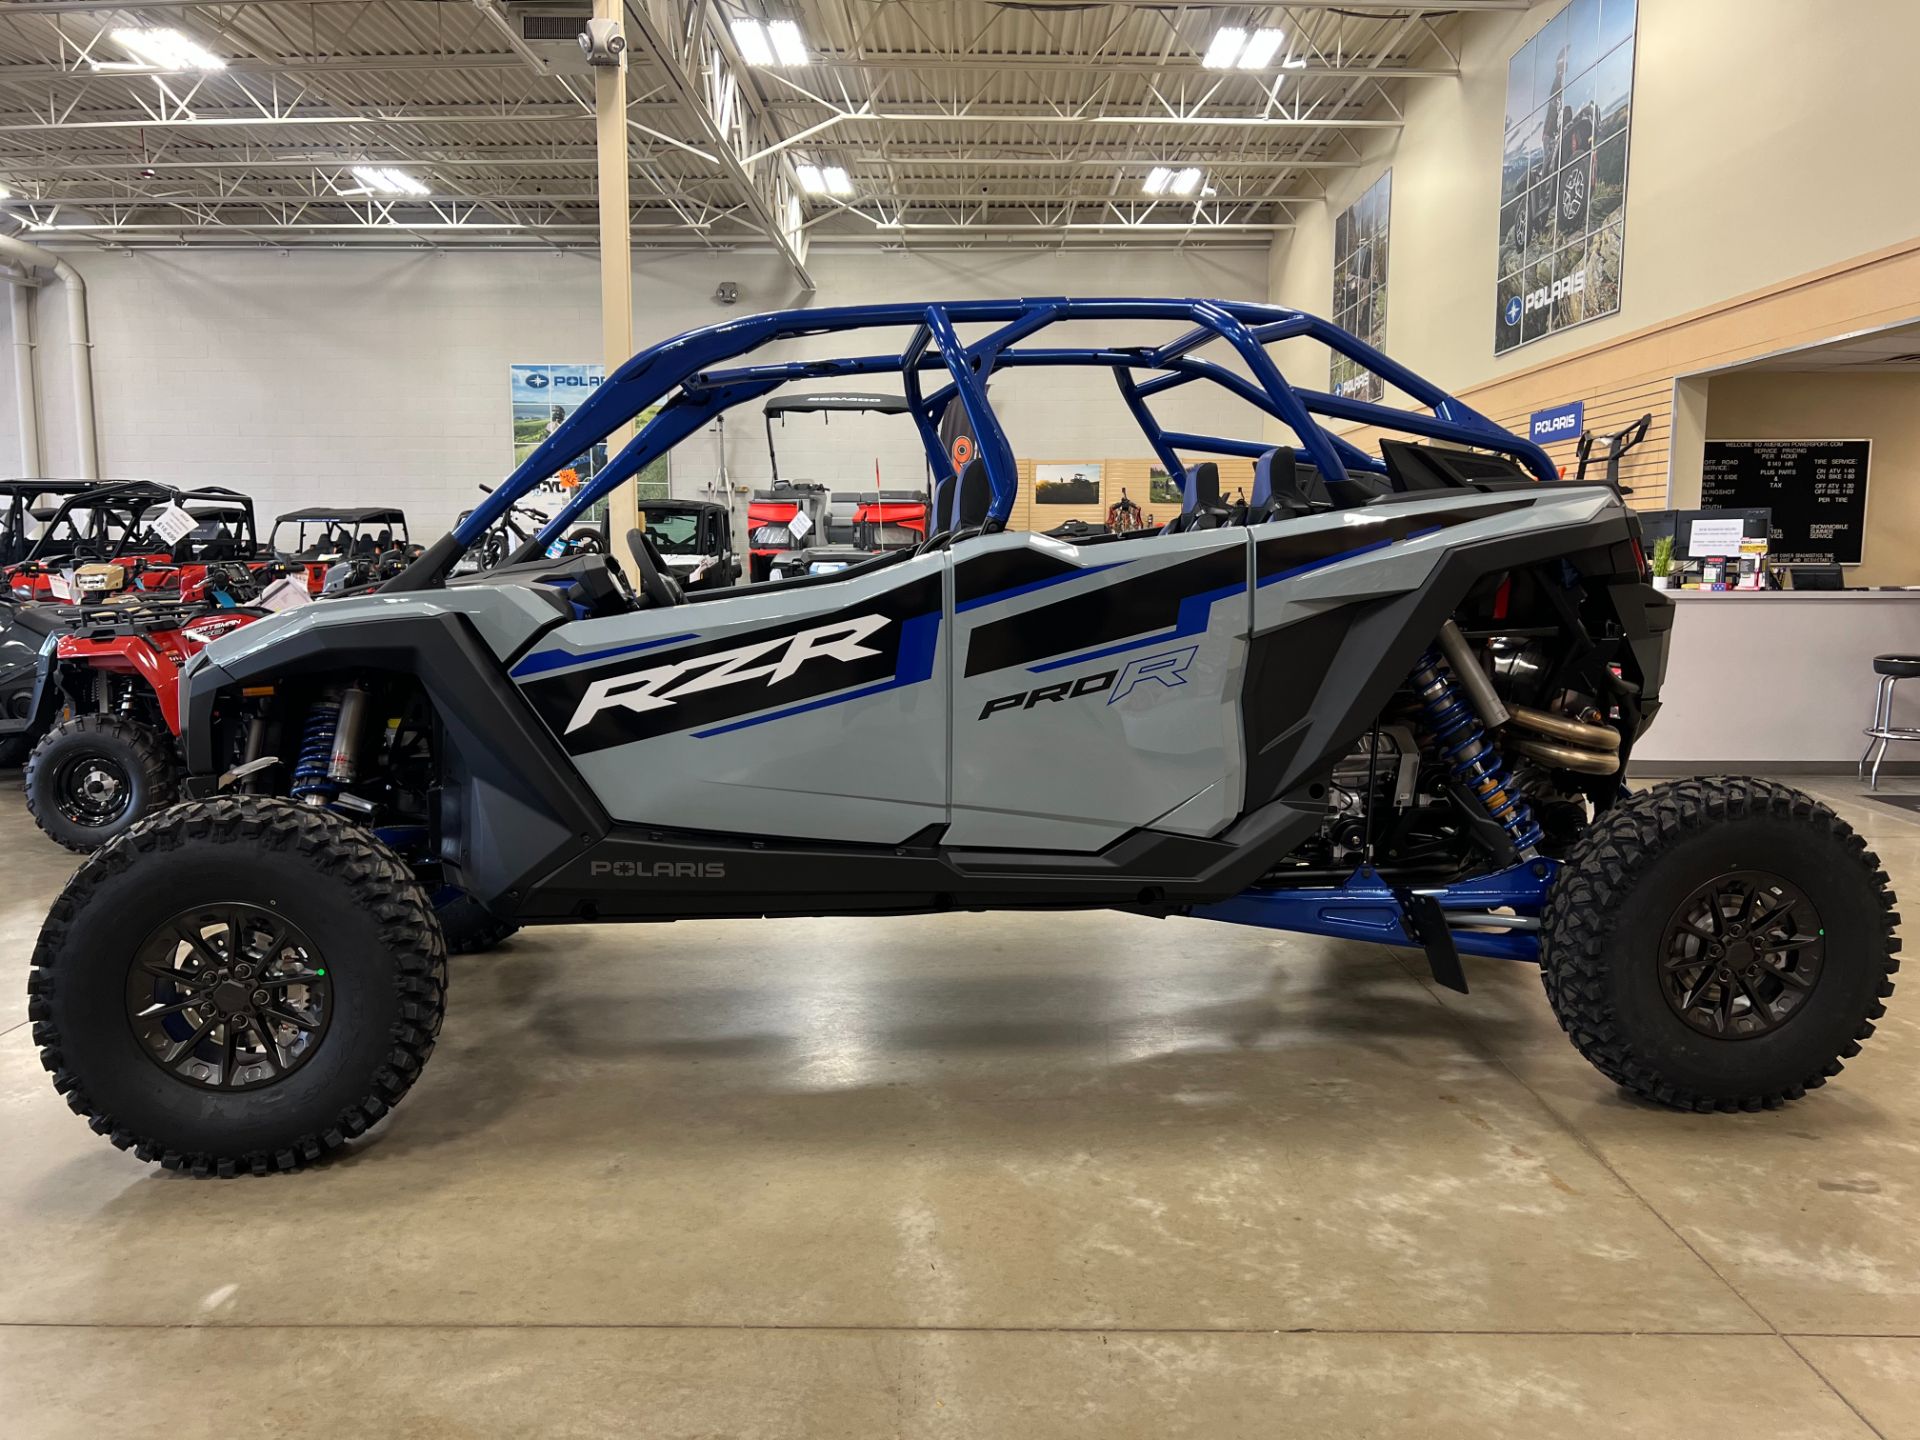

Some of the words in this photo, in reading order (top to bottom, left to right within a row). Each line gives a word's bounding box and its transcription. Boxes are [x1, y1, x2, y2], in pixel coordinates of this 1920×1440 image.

[1525, 270, 1585, 314] POLARIS
[554, 376, 605, 386] POLA
[1534, 414, 1575, 435] POLARIS
[564, 613, 892, 735] RZR
[978, 669, 1119, 721] PRO
[1106, 645, 1199, 706] R
[591, 861, 726, 878] POLARIS
